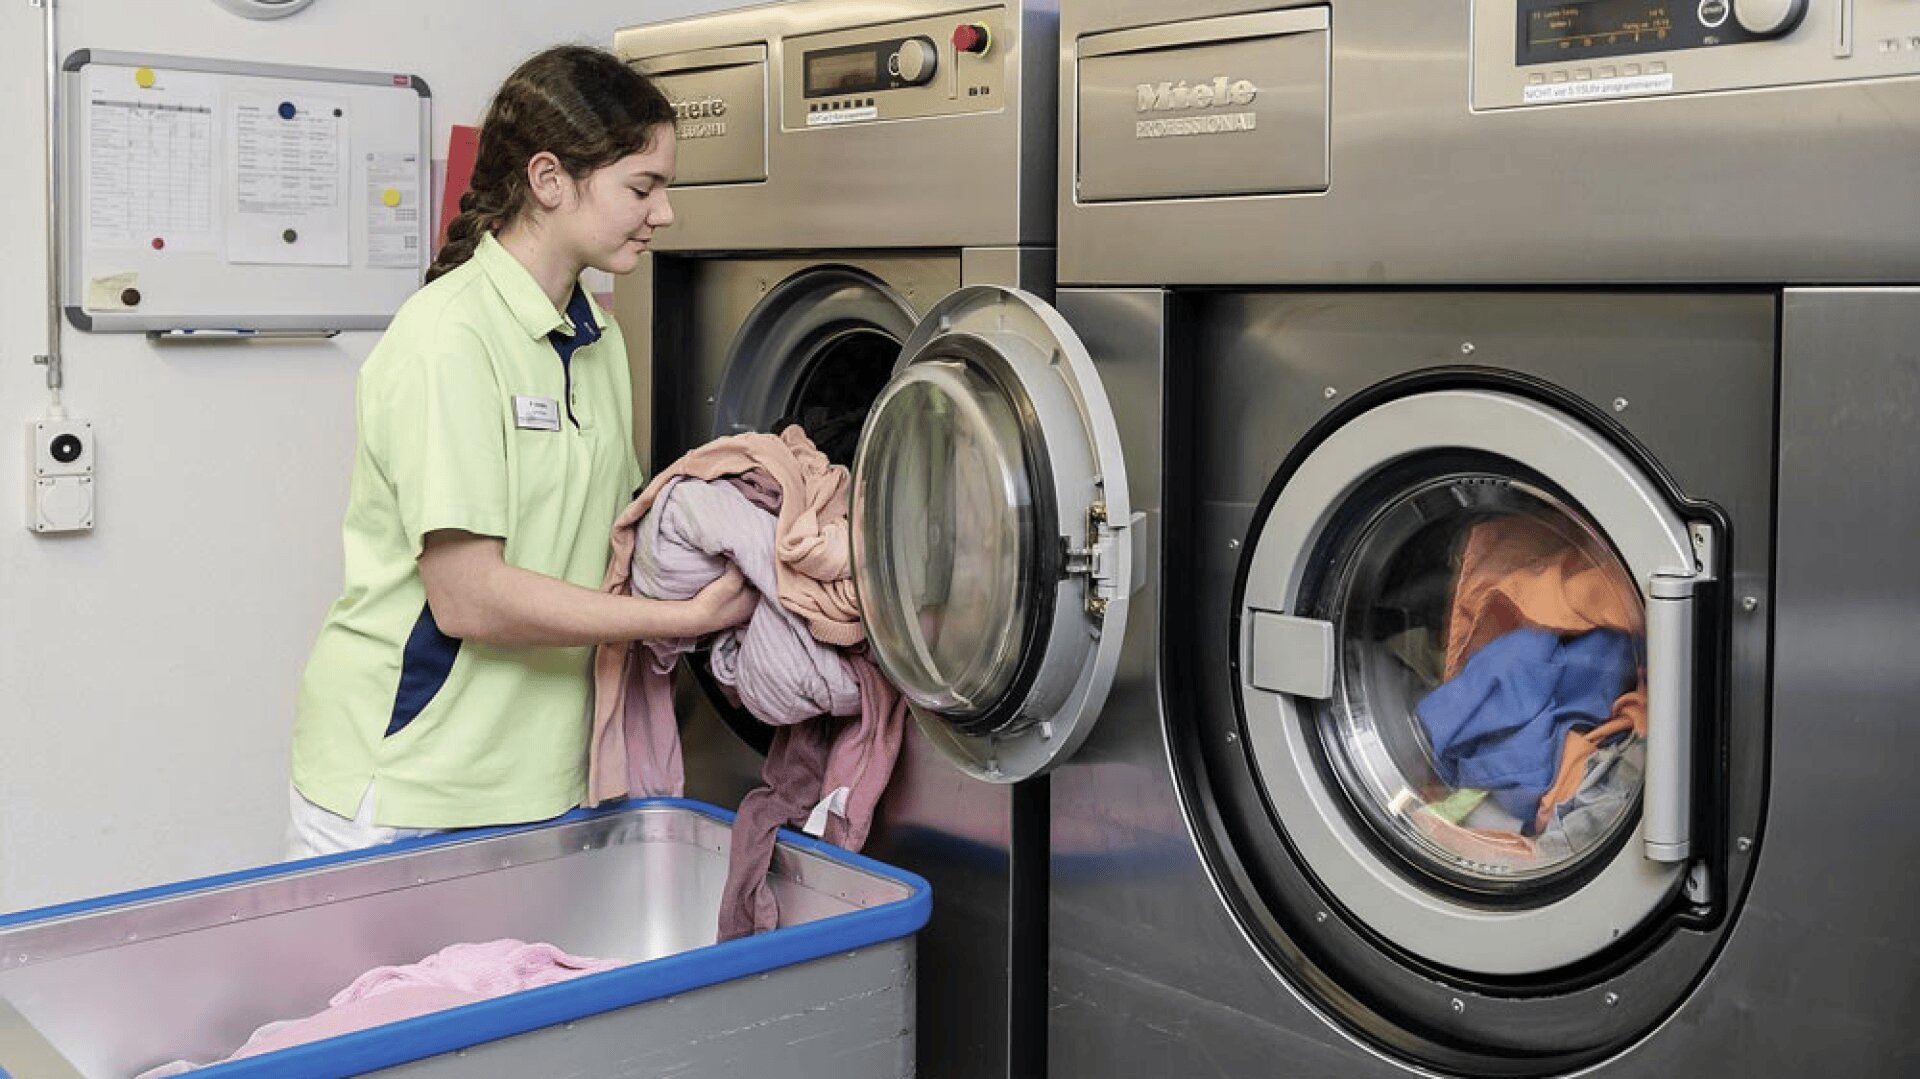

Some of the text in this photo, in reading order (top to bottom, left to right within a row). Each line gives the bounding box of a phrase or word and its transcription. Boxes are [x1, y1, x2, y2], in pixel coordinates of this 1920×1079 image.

[670, 96, 727, 119] iele
[1136, 76, 1257, 112] Miele
[1136, 112, 1257, 139] PROFESSIONAL
